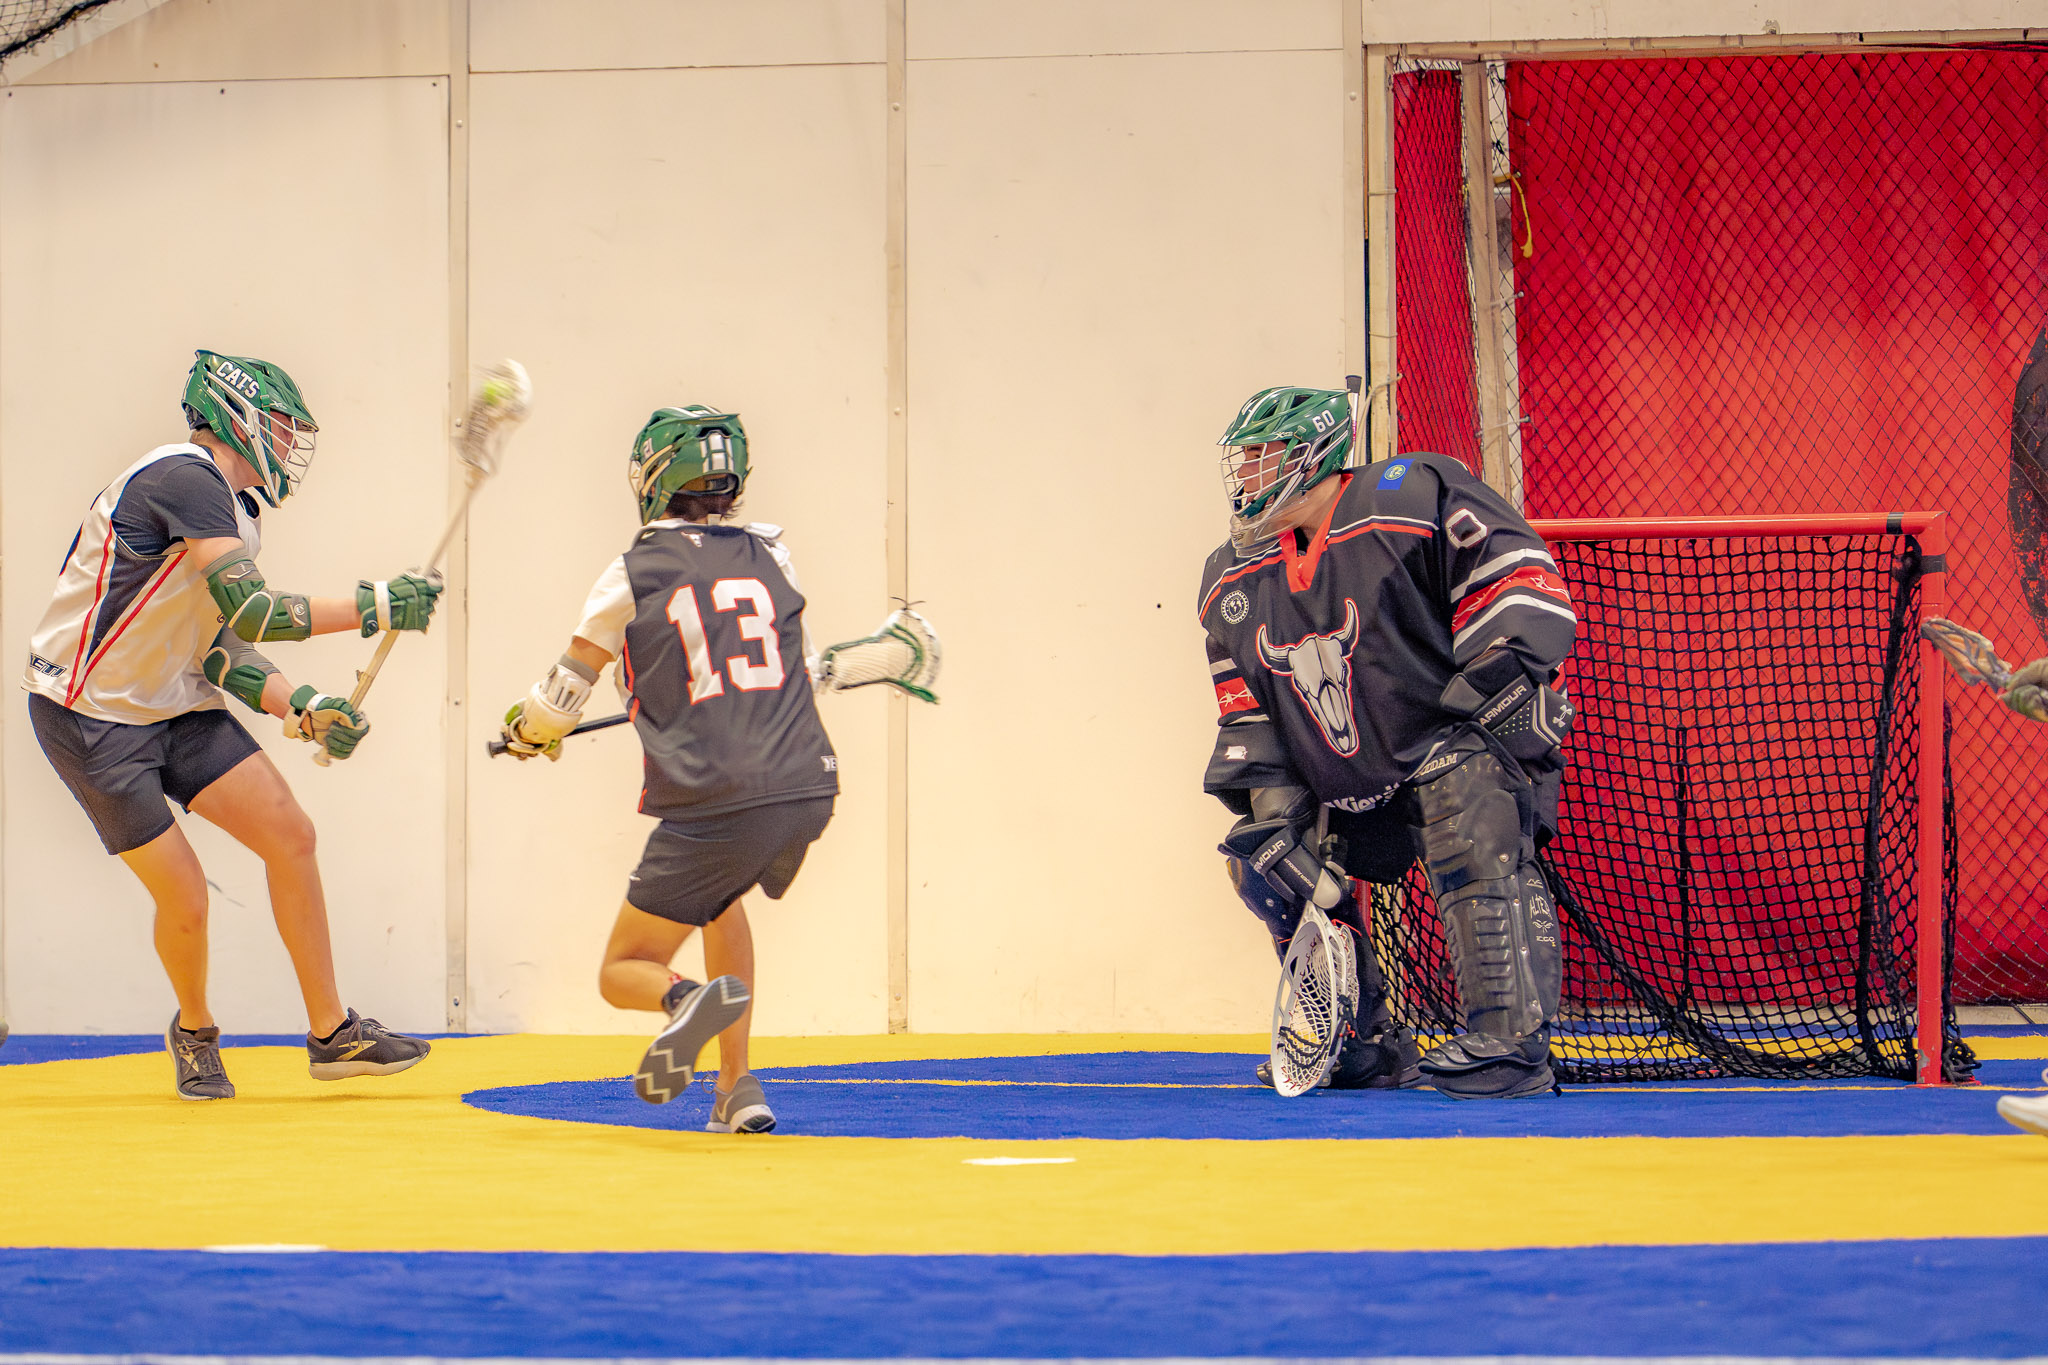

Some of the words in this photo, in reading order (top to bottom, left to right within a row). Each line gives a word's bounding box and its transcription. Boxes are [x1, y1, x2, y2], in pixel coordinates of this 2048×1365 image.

[216, 361, 260, 399] CATS
[1312, 409, 1335, 433] 60
[665, 577, 786, 705] 13
[1479, 684, 1528, 727] ARMOUR
